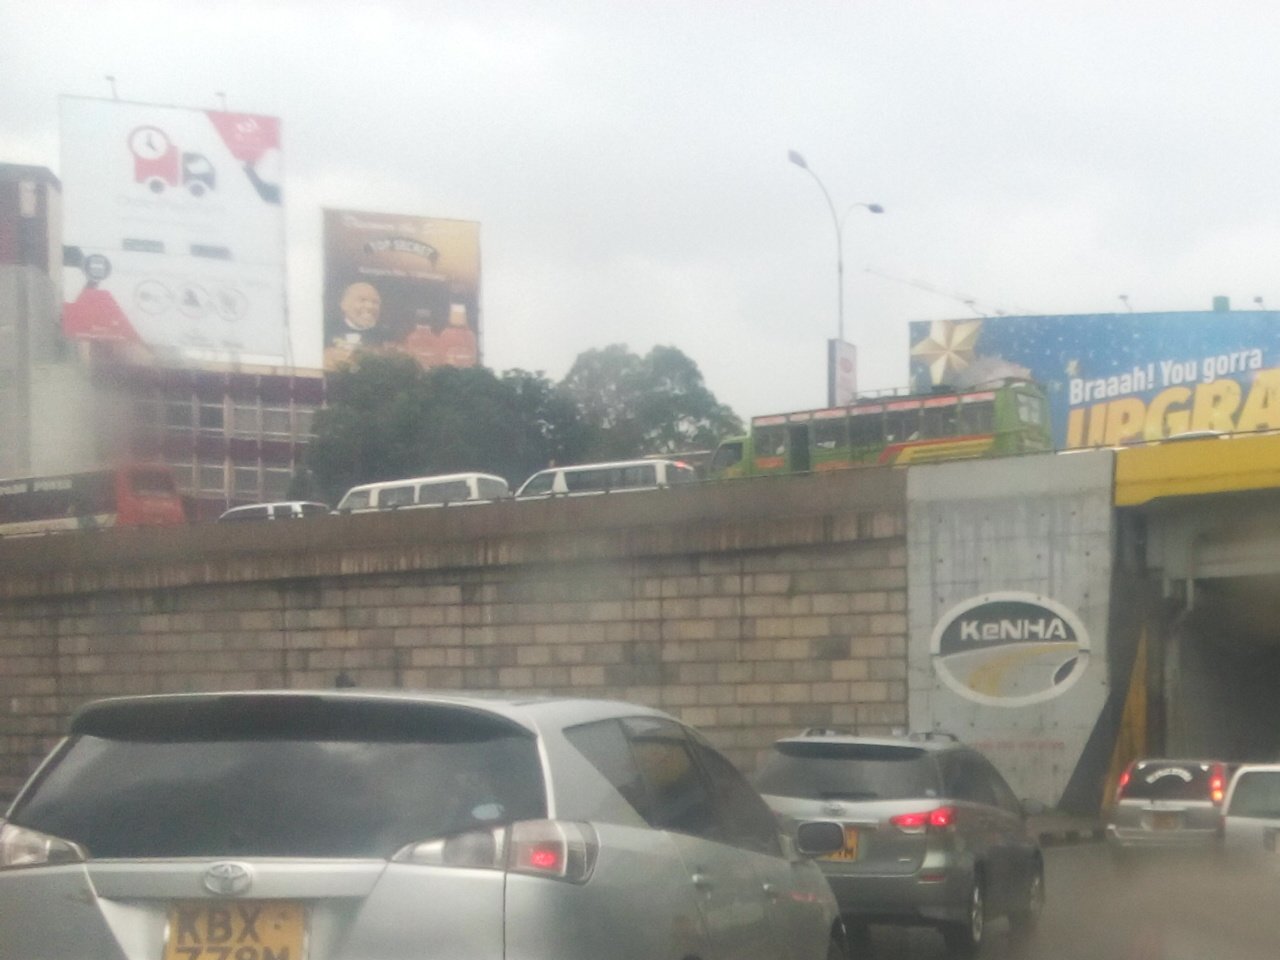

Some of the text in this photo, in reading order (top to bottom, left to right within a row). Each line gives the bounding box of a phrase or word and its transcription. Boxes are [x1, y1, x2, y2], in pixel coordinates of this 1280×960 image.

[1069, 364, 1153, 405] Braaah!
[1160, 359, 1197, 386] You
[960, 618, 1067, 640] KeNHA
[176, 902, 261, 945] KBX
